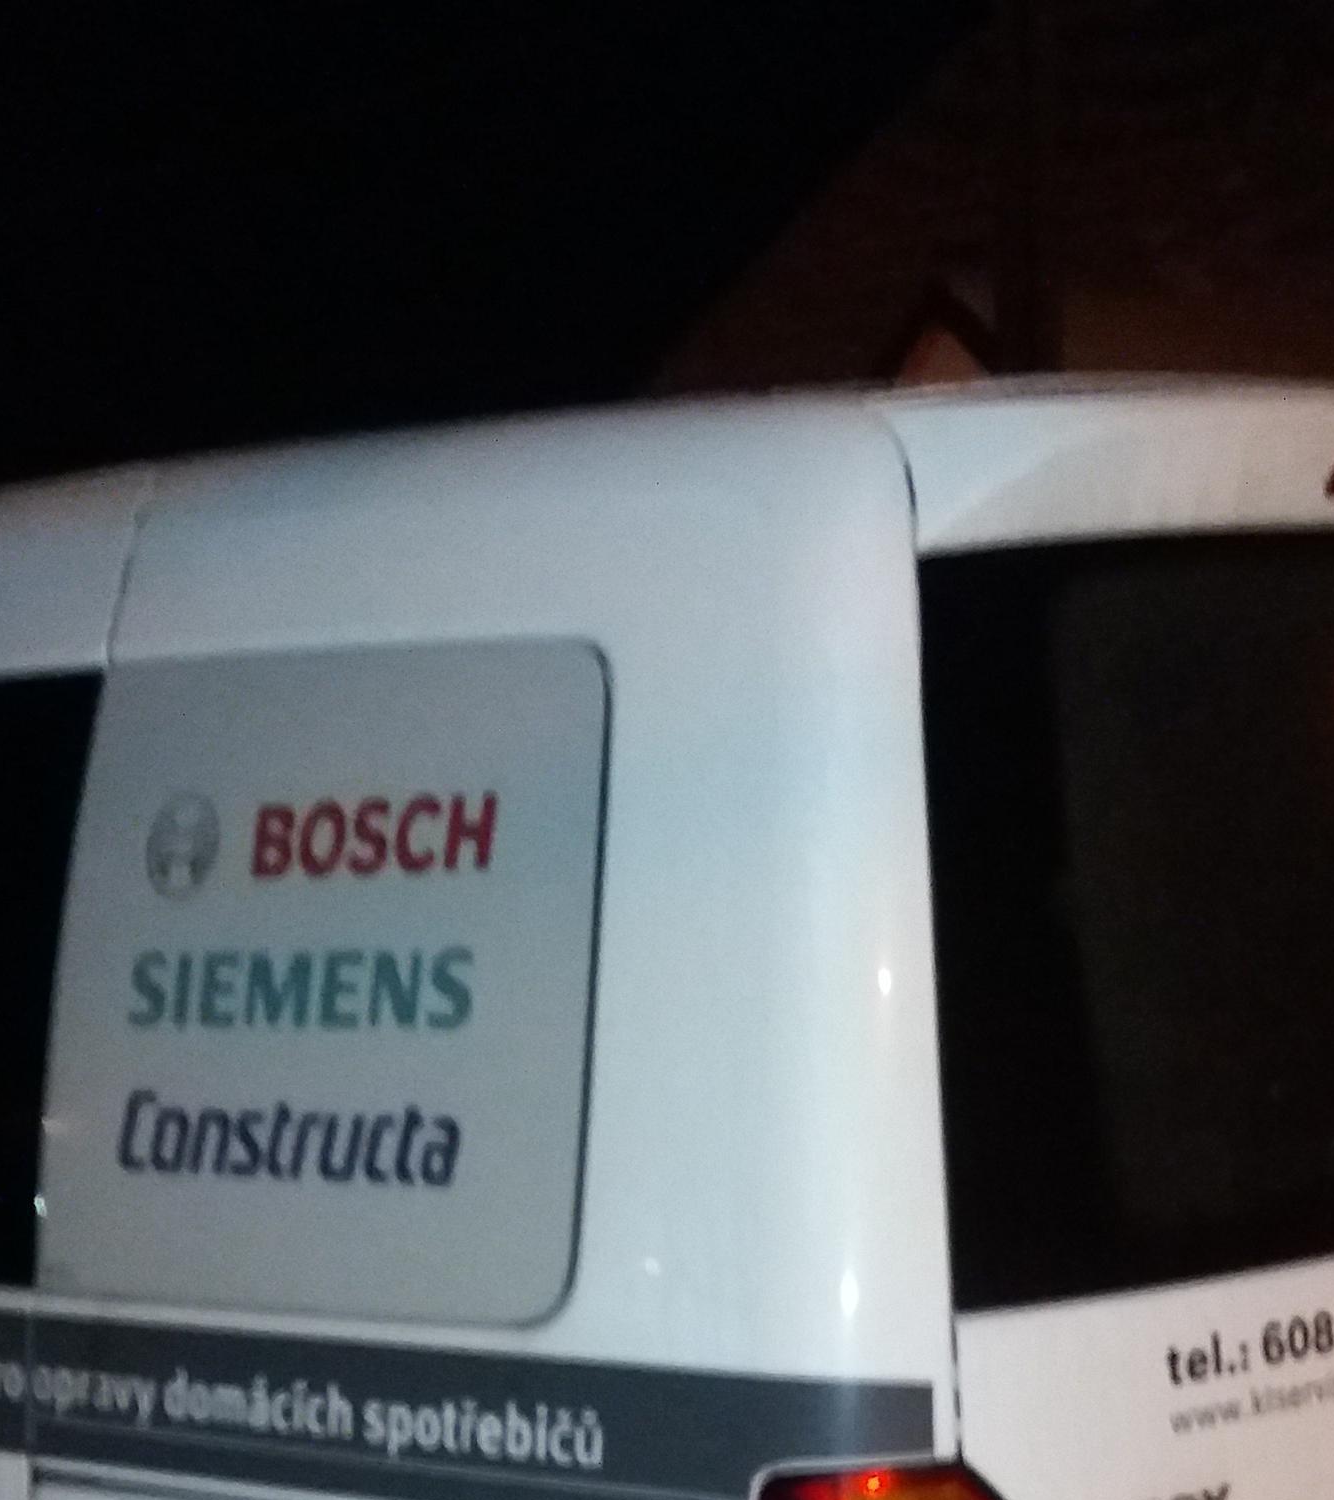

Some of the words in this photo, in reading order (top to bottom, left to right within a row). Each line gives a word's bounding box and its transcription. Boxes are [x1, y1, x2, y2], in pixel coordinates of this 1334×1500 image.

[250, 789, 500, 881] BOSCH
[126, 945, 475, 1031] SIEMENS
[117, 1087, 463, 1187] Constructa
[31, 1365, 155, 1429] opravy
[164, 1365, 354, 1441] domácích
[362, 1396, 605, 1471] spotřebičů
